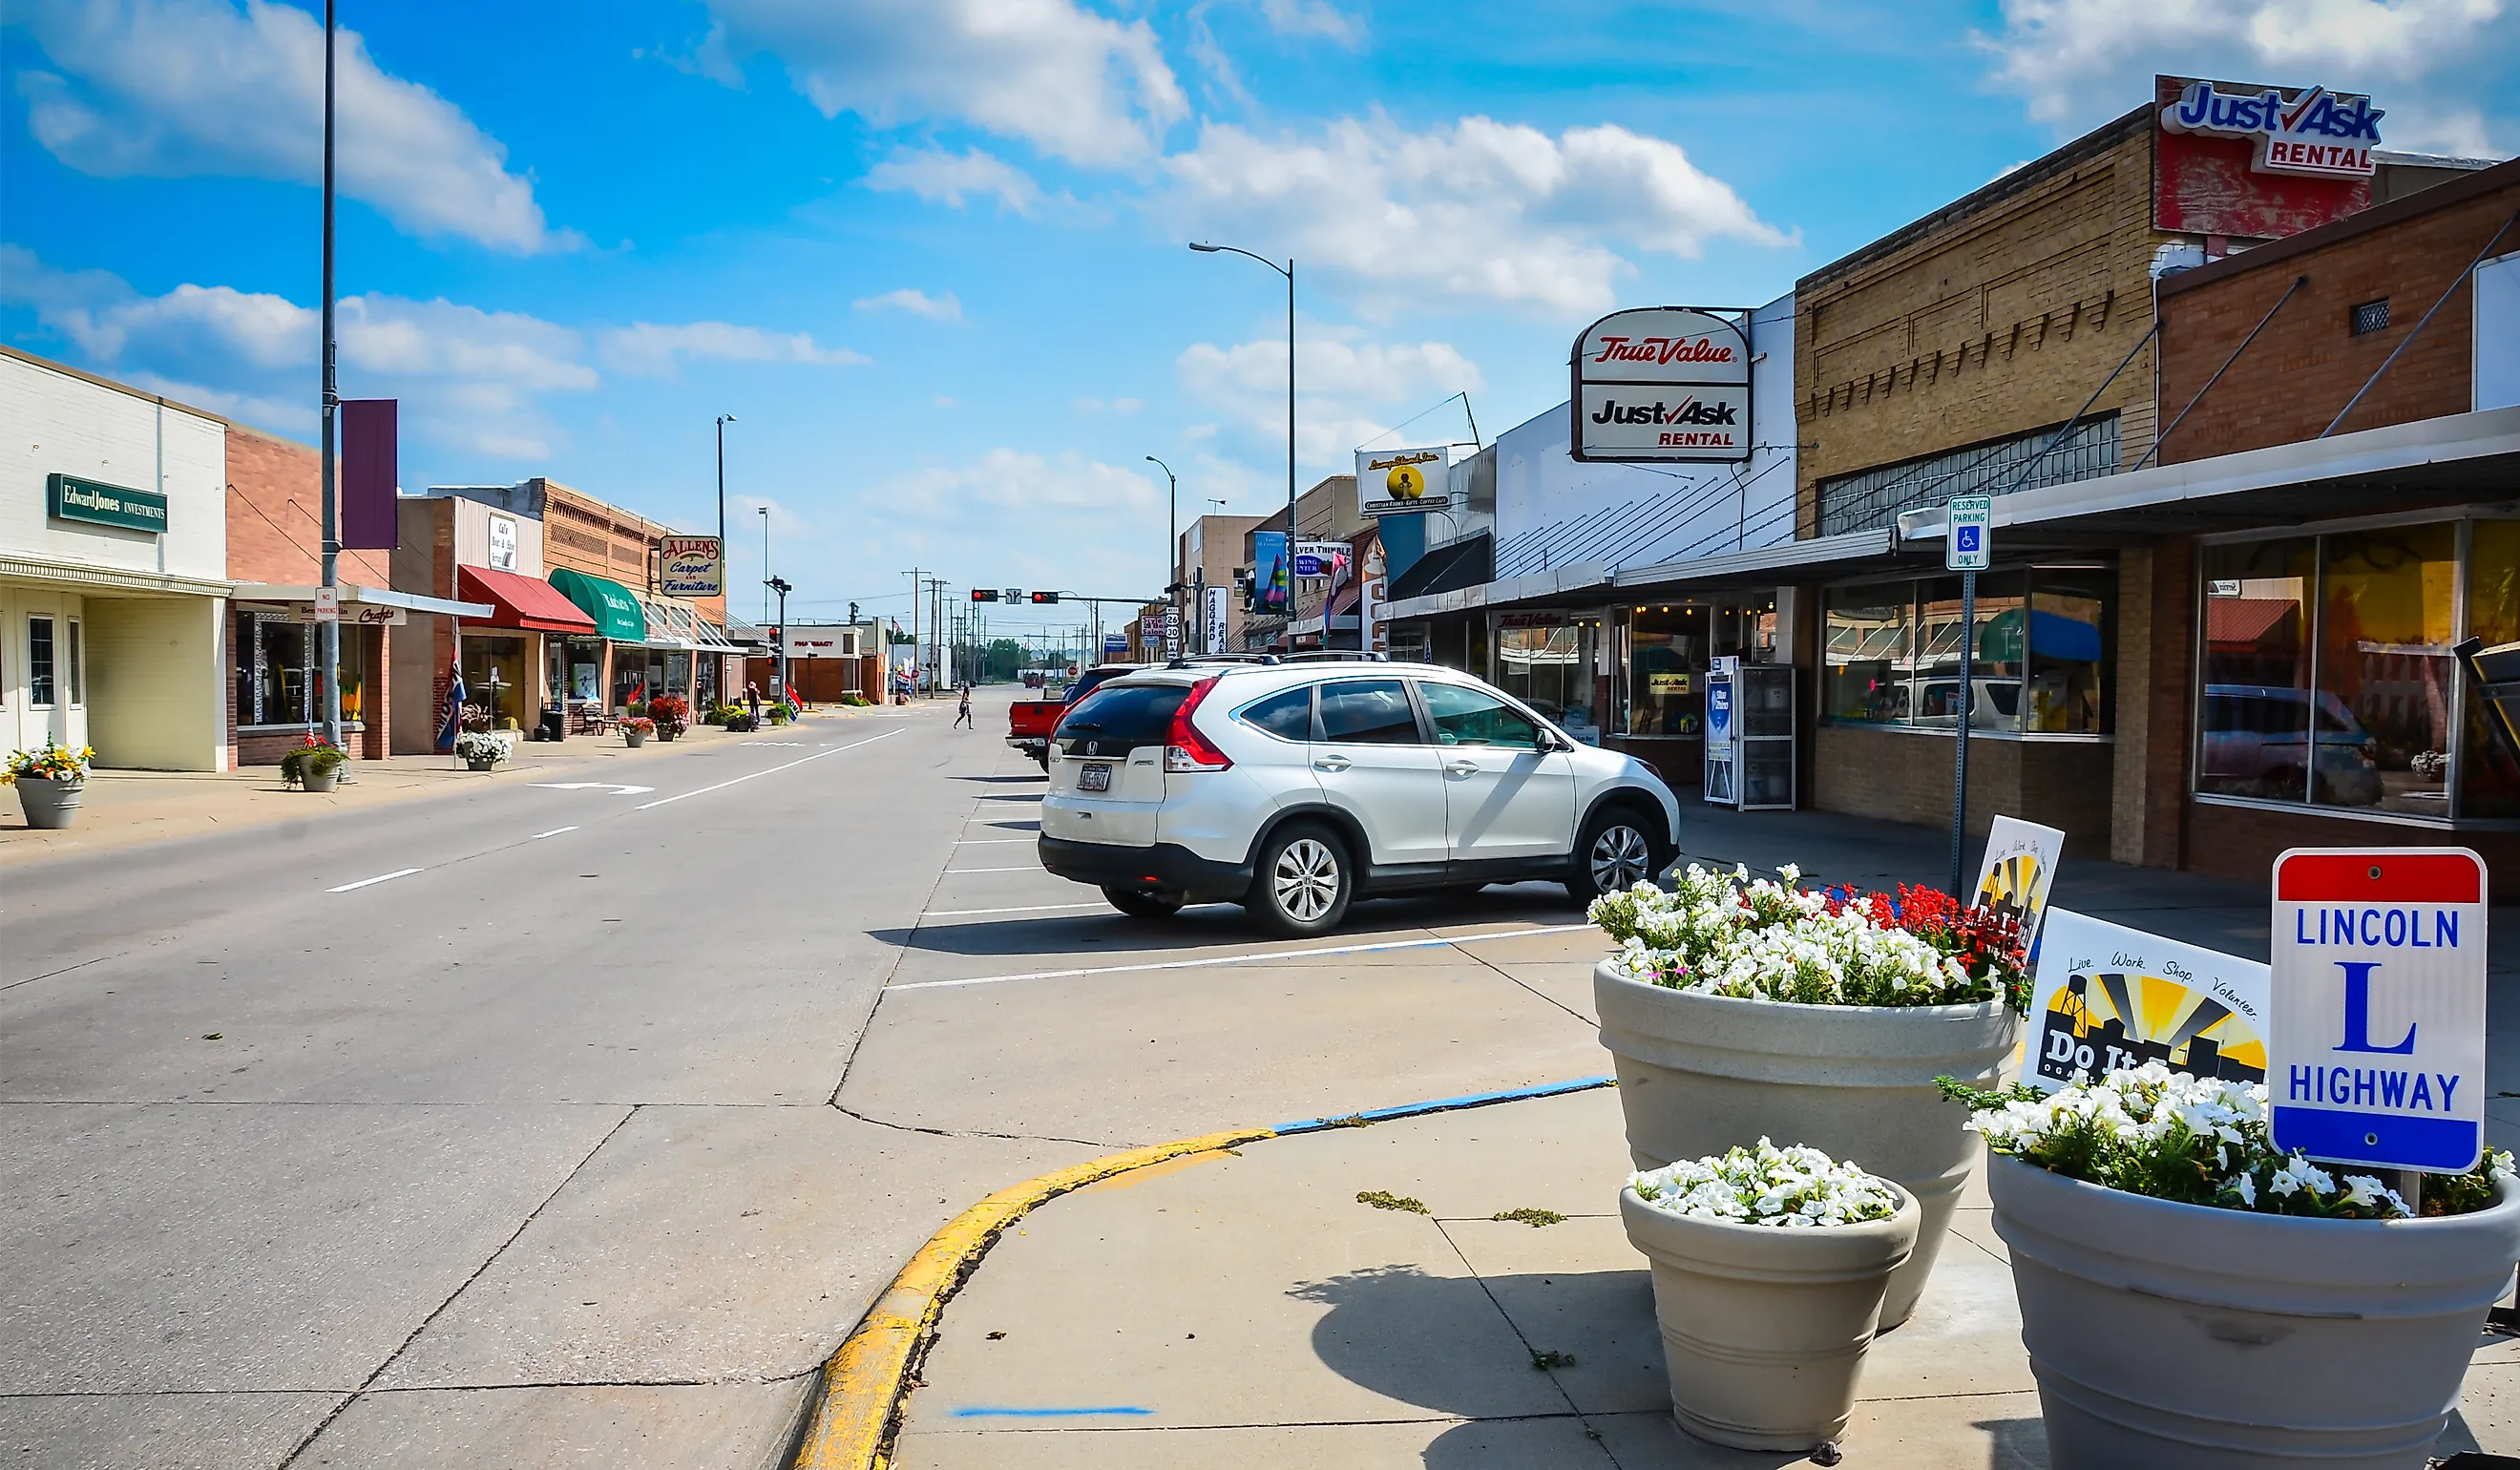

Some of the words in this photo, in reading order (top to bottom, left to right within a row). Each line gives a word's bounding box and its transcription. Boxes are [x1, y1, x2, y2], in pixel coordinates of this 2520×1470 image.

[2180, 86, 2280, 132] Just
[2296, 96, 2384, 139] Ask
[2270, 140, 2372, 169] RENTAL
[1591, 399, 1666, 425] Just
[1673, 401, 1738, 426] Ask
[1658, 432, 1733, 446] RENTAL
[123, 501, 165, 519] INVESTMENTS
[1952, 499, 1988, 511] RESERVED
[1953, 512, 1985, 523] PARKING
[669, 560, 714, 577] Carpet
[1958, 554, 1979, 565] ONLY
[663, 578, 719, 591] Furniture
[359, 605, 395, 624] Crafts
[1167, 628, 1178, 637] 30
[1650, 678, 1670, 686] Just
[1671, 678, 1688, 686] Ask
[2297, 908, 2459, 948] LINCOLN
[2068, 956, 2094, 974] Live.
[2110, 951, 2146, 970] Work.
[2163, 960, 2194, 983] Shop.
[2211, 976, 2258, 1021] Volunteer.
[2331, 960, 2417, 1056] L
[2046, 1029, 2095, 1069] Do
[2289, 1063, 2460, 1112] HIGHWAY
